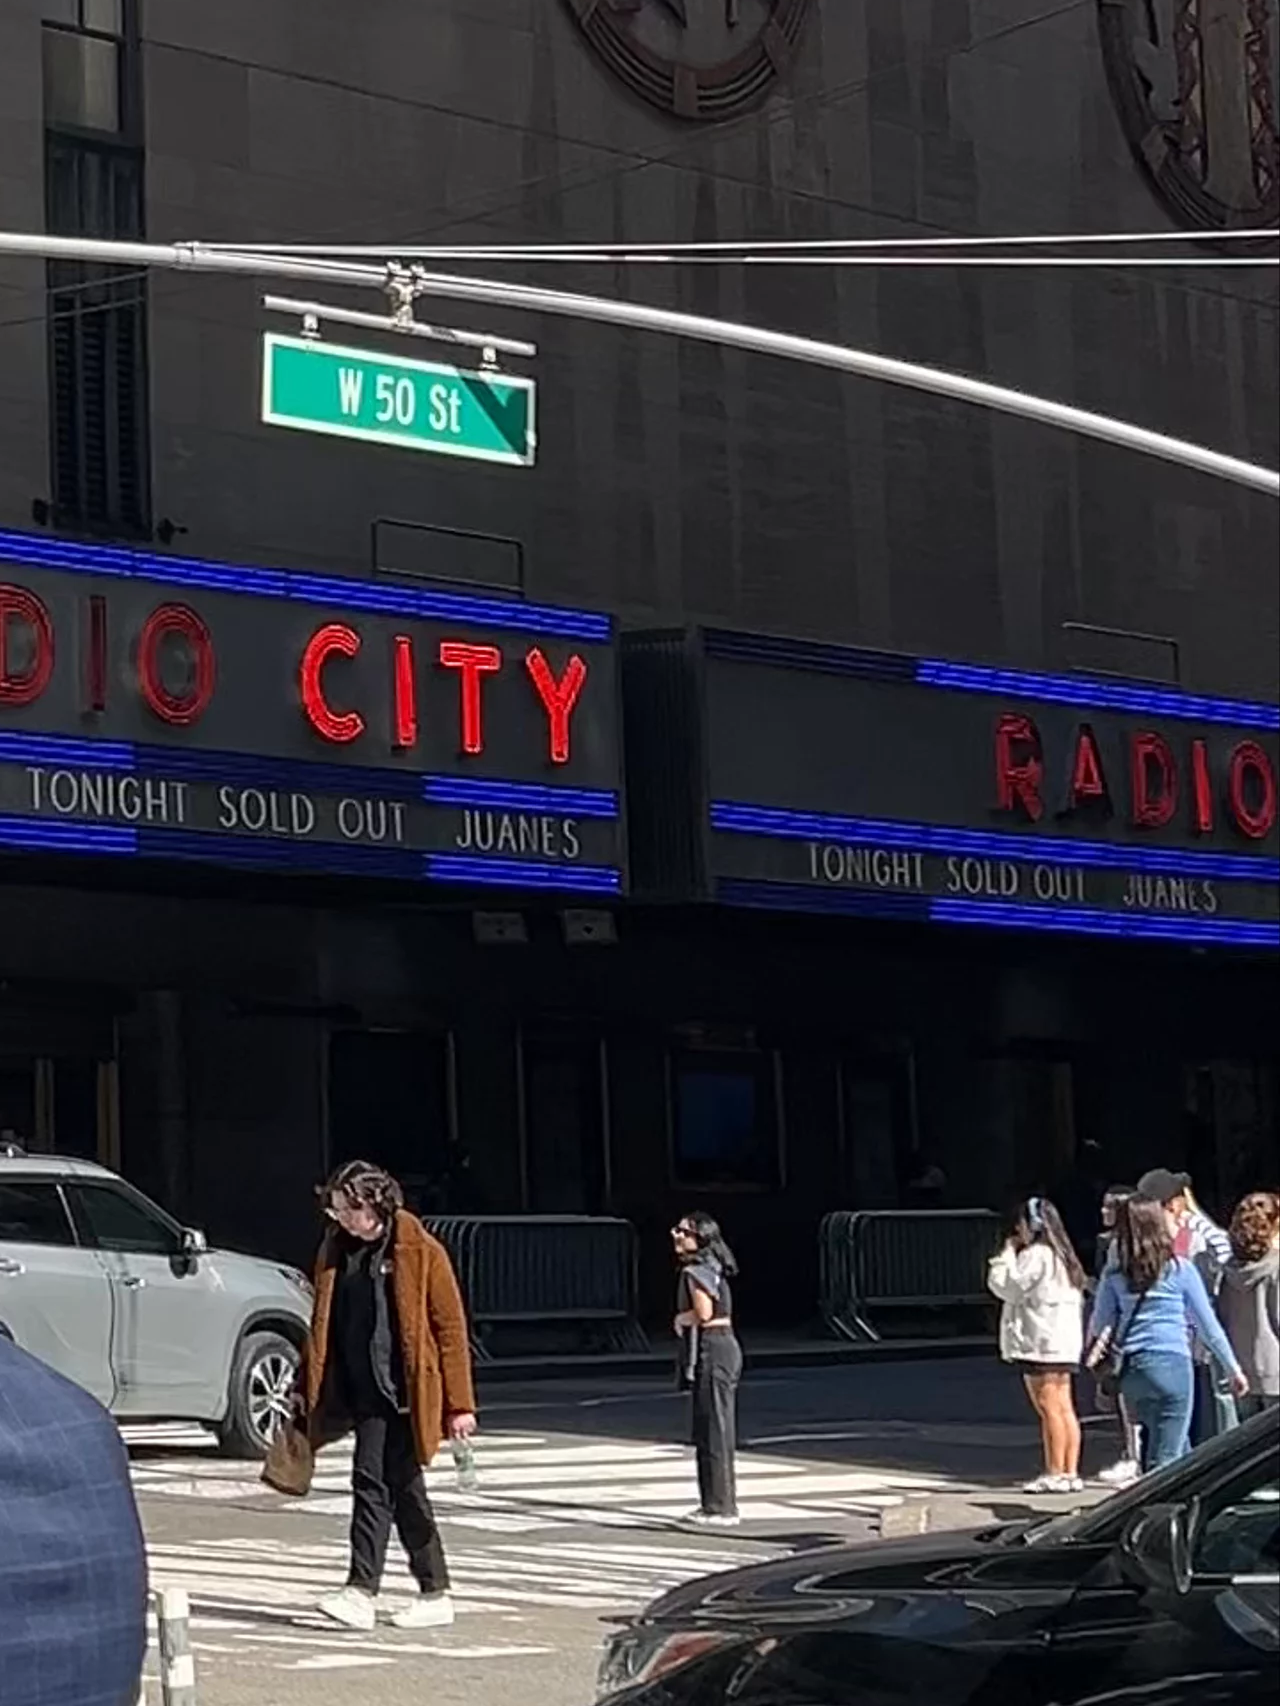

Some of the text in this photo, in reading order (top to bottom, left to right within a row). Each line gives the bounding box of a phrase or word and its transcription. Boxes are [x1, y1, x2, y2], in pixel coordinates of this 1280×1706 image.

[338, 367, 462, 434] W 50 St
[300, 623, 588, 763] CITY
[28, 766, 190, 824] TONIGHT
[218, 784, 315, 836] SOLD
[338, 796, 407, 843] OUT
[455, 809, 581, 860] JUANES
[993, 712, 1277, 839] RADIO
[808, 842, 1220, 914] TONIGHT SOLD OUT JUANES
